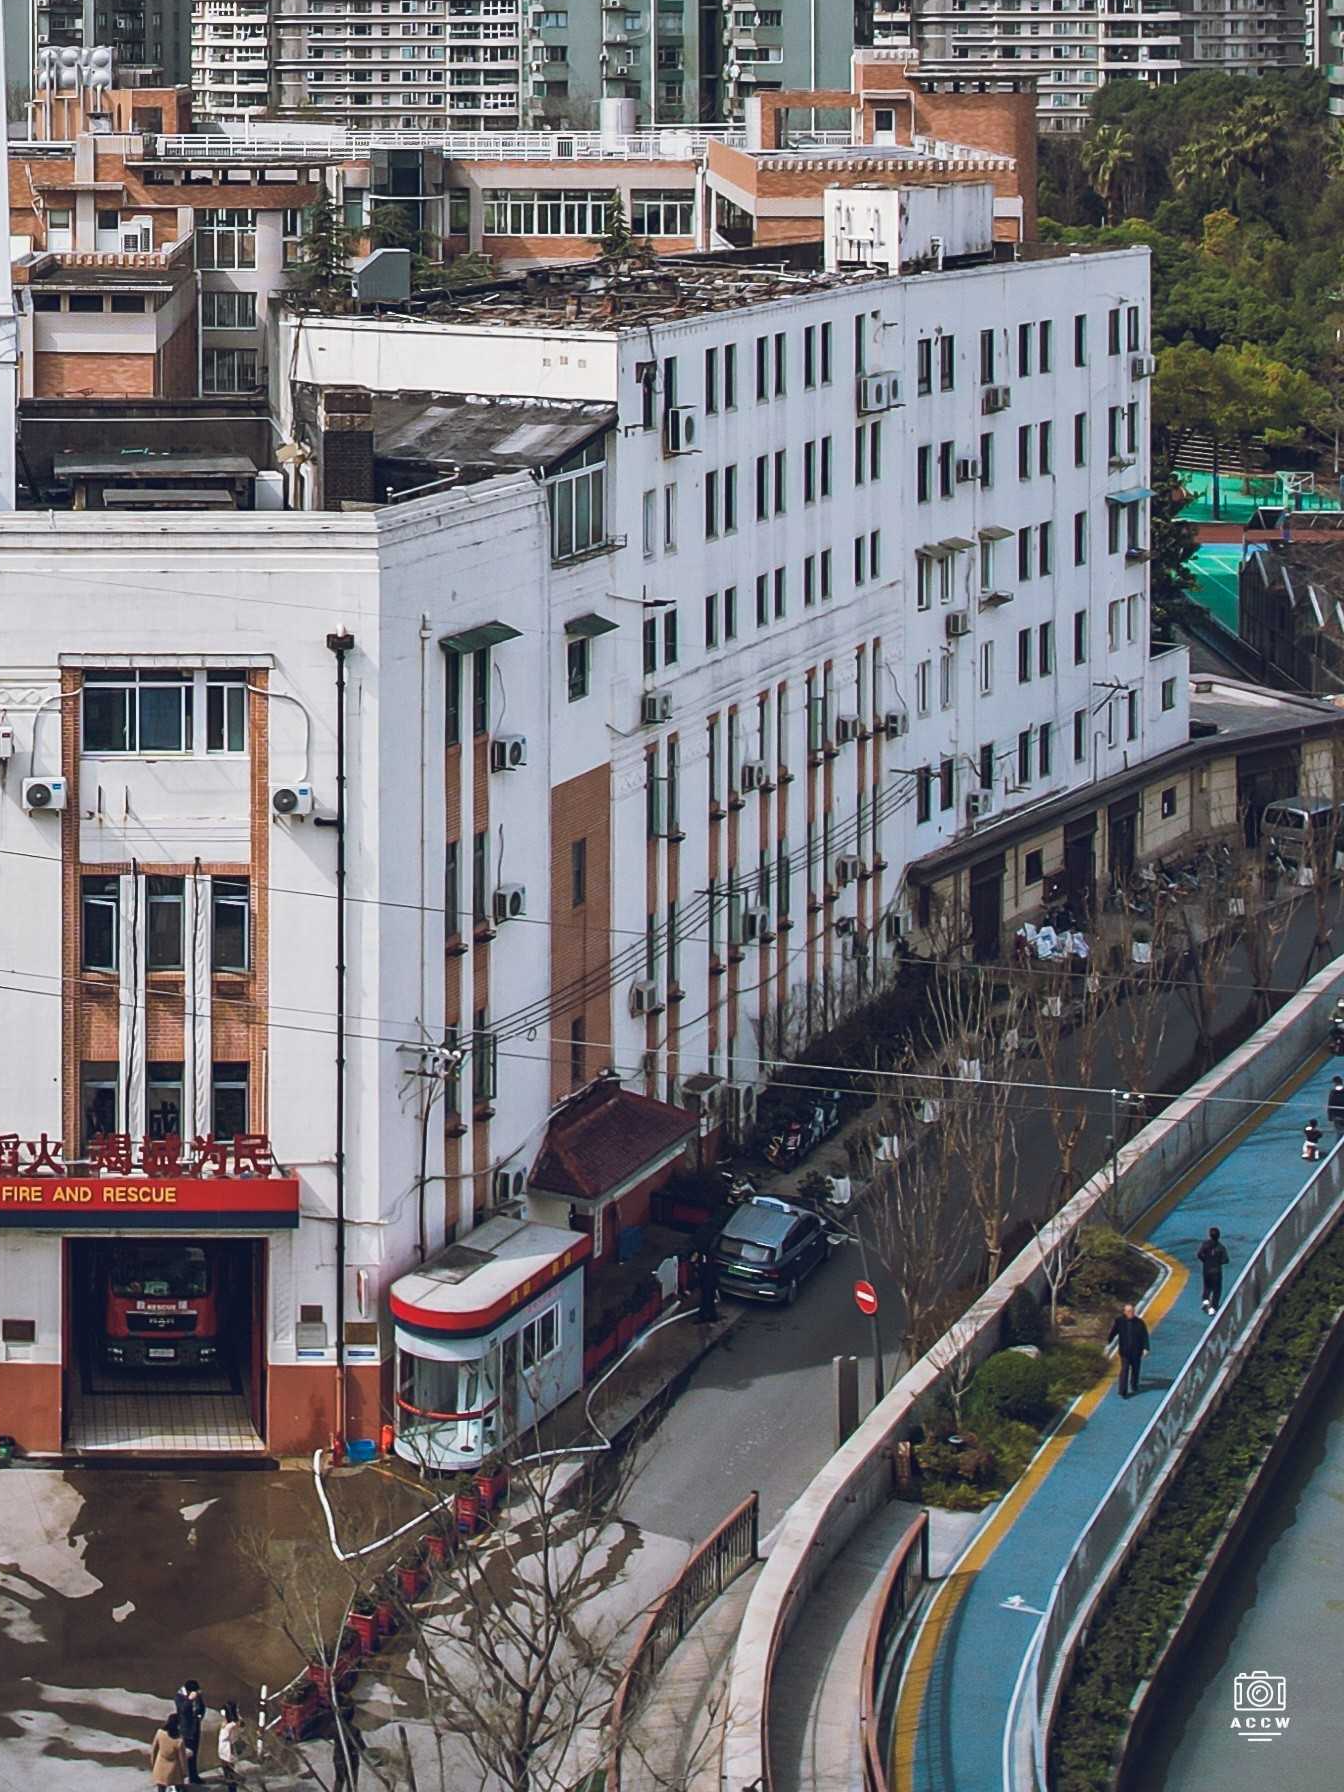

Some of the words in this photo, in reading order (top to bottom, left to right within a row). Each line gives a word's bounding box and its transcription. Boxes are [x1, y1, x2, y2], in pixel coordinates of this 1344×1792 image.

[89, 1132, 274, 1178] 竭诚为民
[1, 1185, 43, 1202] FIRE
[52, 1186, 92, 1202] AND
[102, 1186, 177, 1203] RESCUE
